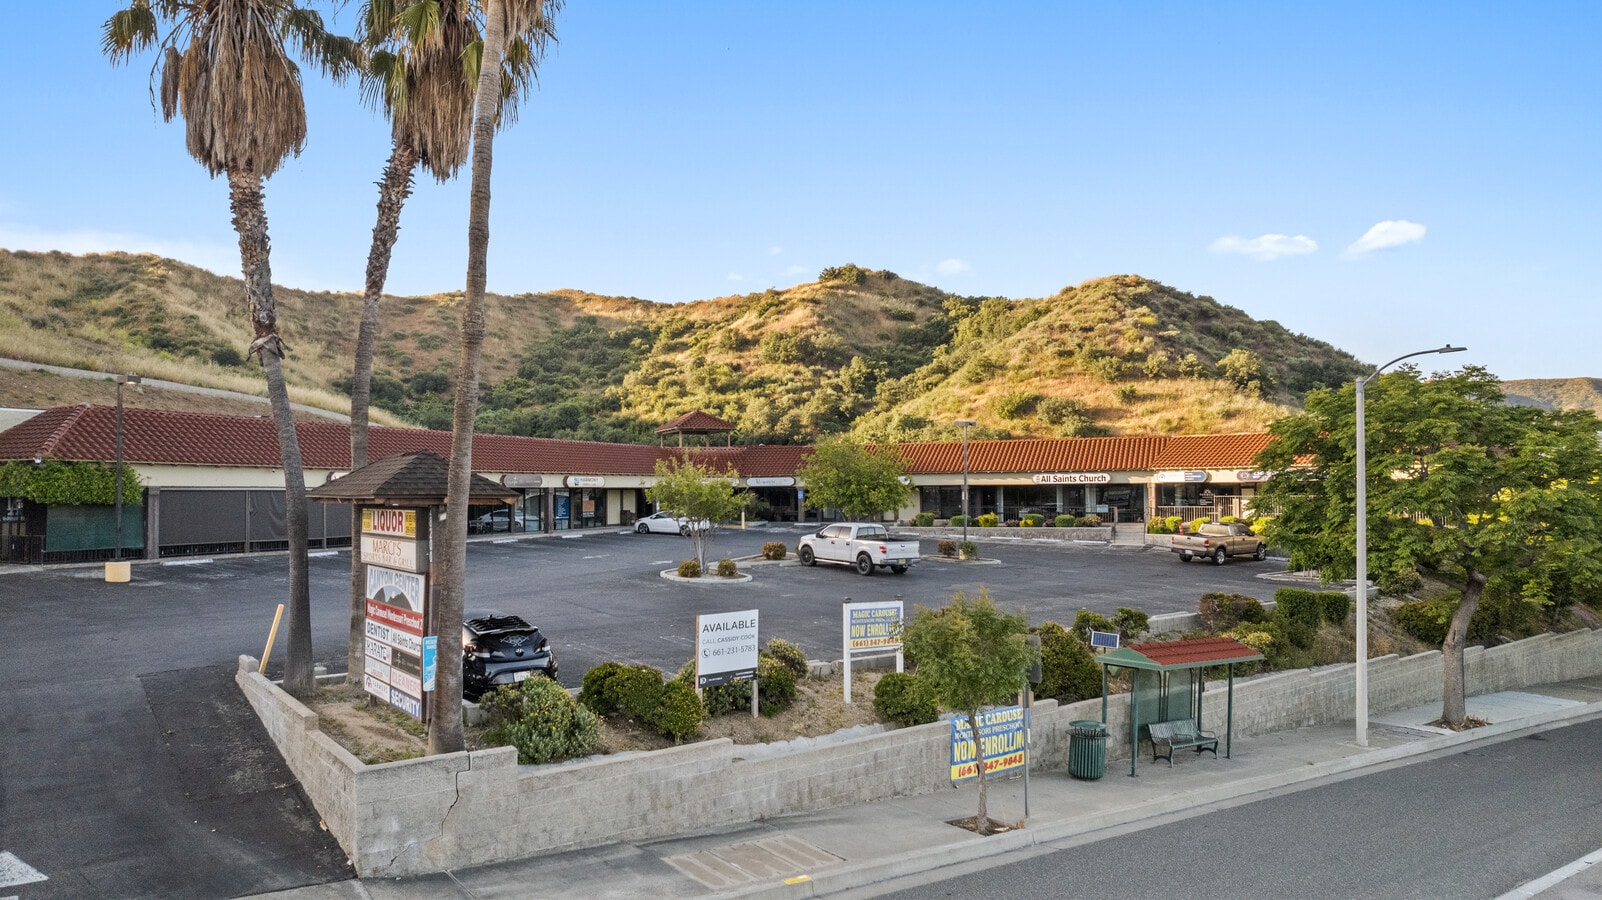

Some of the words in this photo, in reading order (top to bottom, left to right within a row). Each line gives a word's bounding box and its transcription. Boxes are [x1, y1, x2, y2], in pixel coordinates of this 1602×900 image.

[1040, 475, 1051, 483] All
[1052, 474, 1077, 483] Saints
[1078, 474, 1107, 482] Church
[372, 510, 404, 533] LIQUOR
[366, 621, 390, 641] DENTIST
[702, 618, 756, 634] AVAILABLE
[851, 624, 866, 638] NOW
[867, 623, 900, 637] ENROLL
[717, 635, 740, 643] CASSIDY
[852, 639, 869, 648] (661)
[366, 639, 387, 661] KARATE
[712, 644, 756, 657] 661-231-5783
[391, 689, 420, 718] SECURITY
[955, 715, 984, 730] MAIC
[954, 740, 977, 762] NOW
[958, 764, 977, 777] (661
